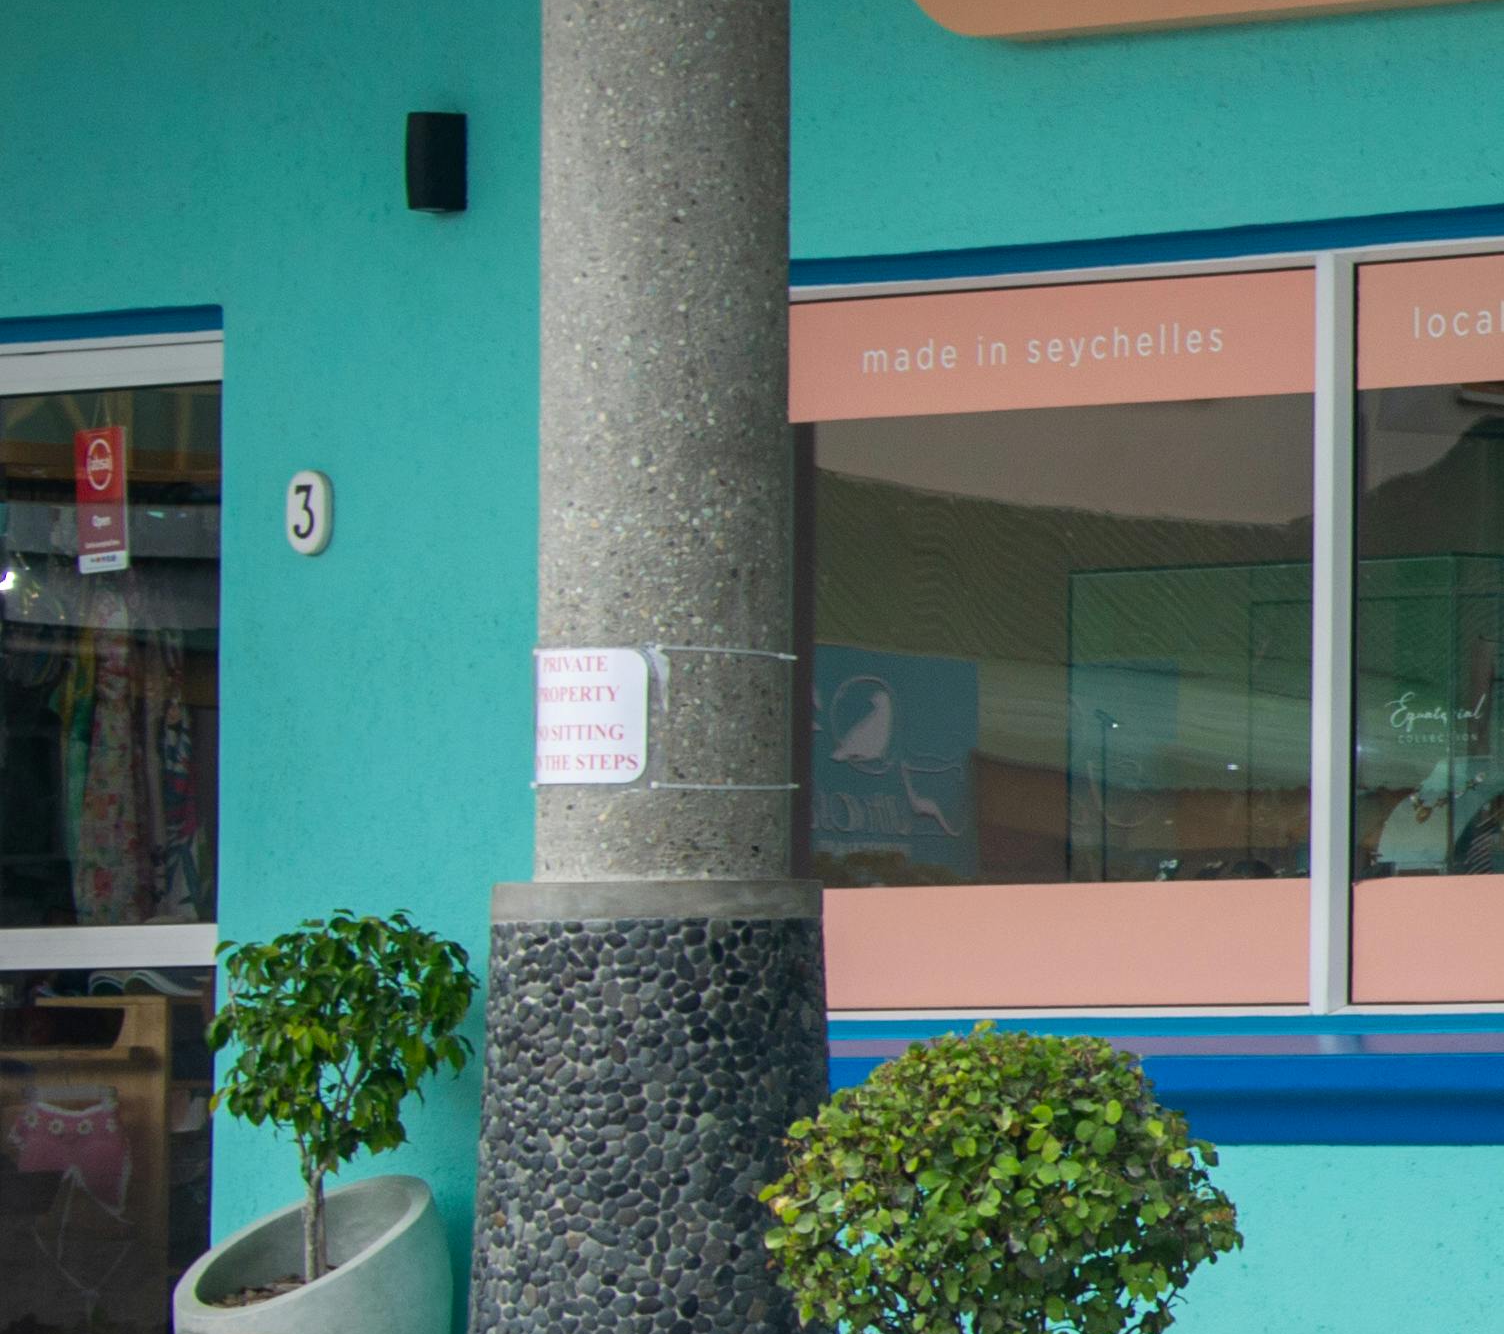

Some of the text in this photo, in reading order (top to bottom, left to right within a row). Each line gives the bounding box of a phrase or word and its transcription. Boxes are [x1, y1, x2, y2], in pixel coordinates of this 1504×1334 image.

[861, 321, 1226, 376] made in seychelles
[293, 484, 314, 540] 3
[543, 655, 608, 673] PRIVATE
[551, 723, 624, 741] SITTING
[545, 754, 570, 771] THE
[576, 753, 639, 771] STEPS
